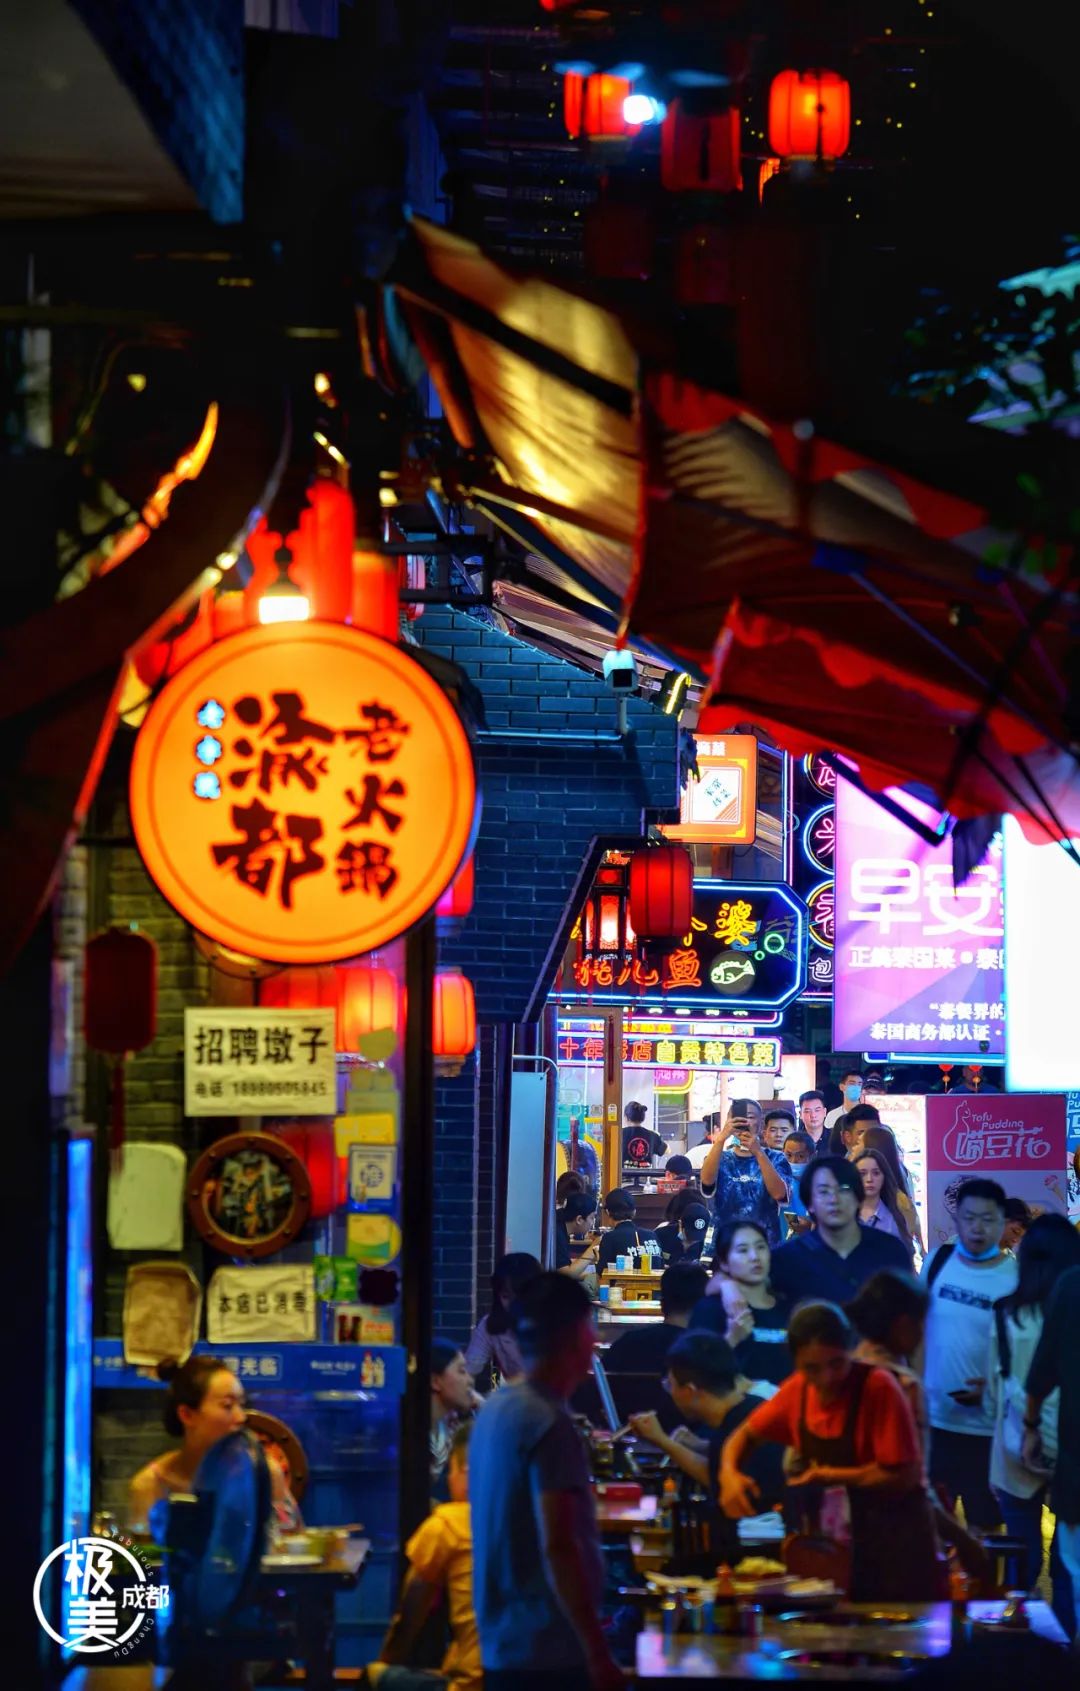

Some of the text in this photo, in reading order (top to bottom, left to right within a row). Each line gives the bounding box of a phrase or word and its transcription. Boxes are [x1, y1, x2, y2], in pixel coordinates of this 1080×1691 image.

[337, 698, 411, 900] 老火锅
[194, 1026, 328, 1066] 招聘墩子
[972, 1111, 993, 1123] Tofu
[981, 1119, 1025, 1133] Pudding
